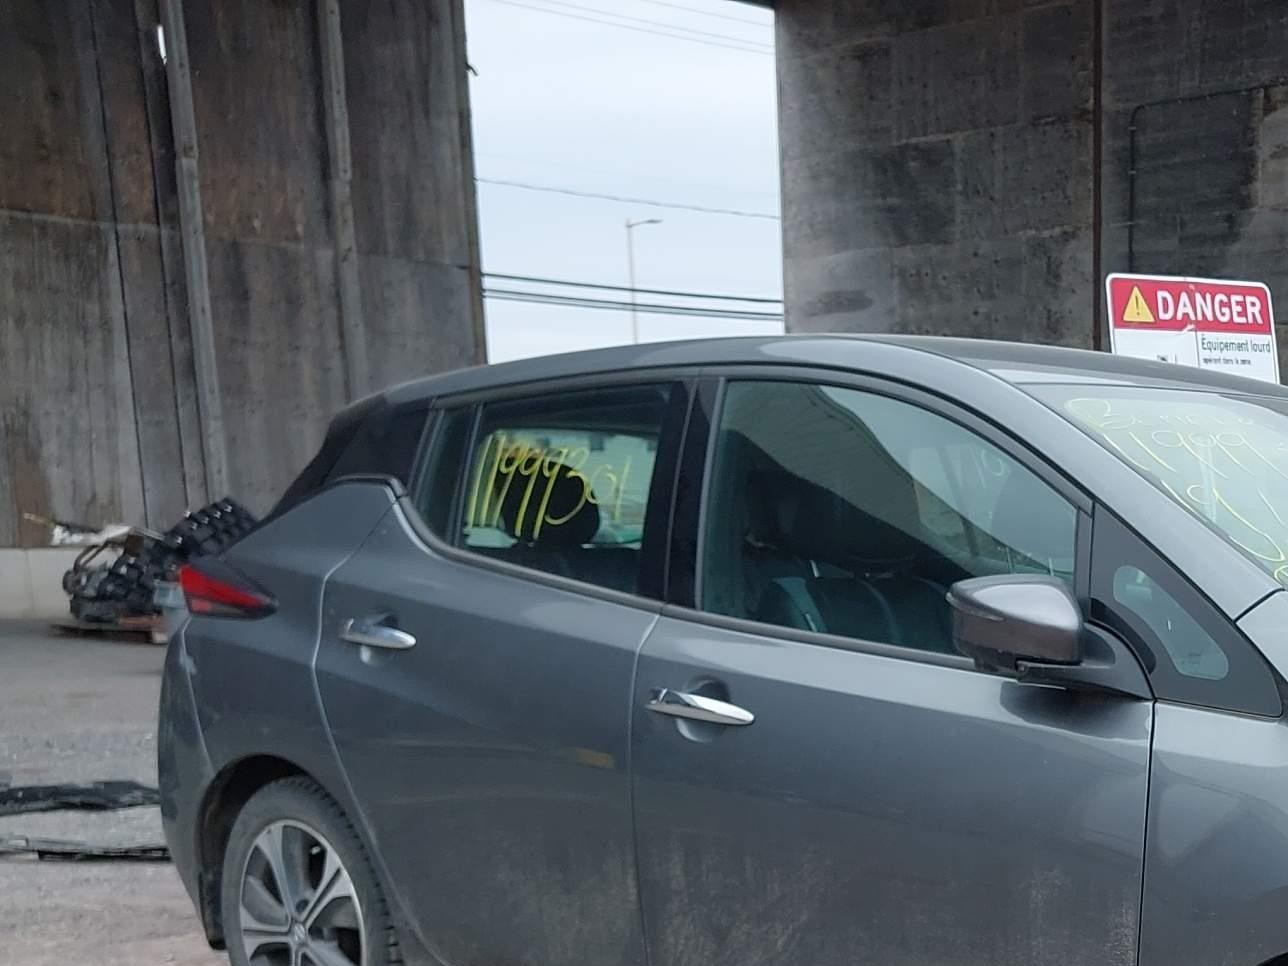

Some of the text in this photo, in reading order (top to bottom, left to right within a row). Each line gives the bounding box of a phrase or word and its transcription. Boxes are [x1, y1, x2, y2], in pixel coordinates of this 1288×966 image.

[1156, 290, 1263, 325] DANGER
[1250, 338, 1271, 353] lourd
[467, 433, 632, 540] 11999301
